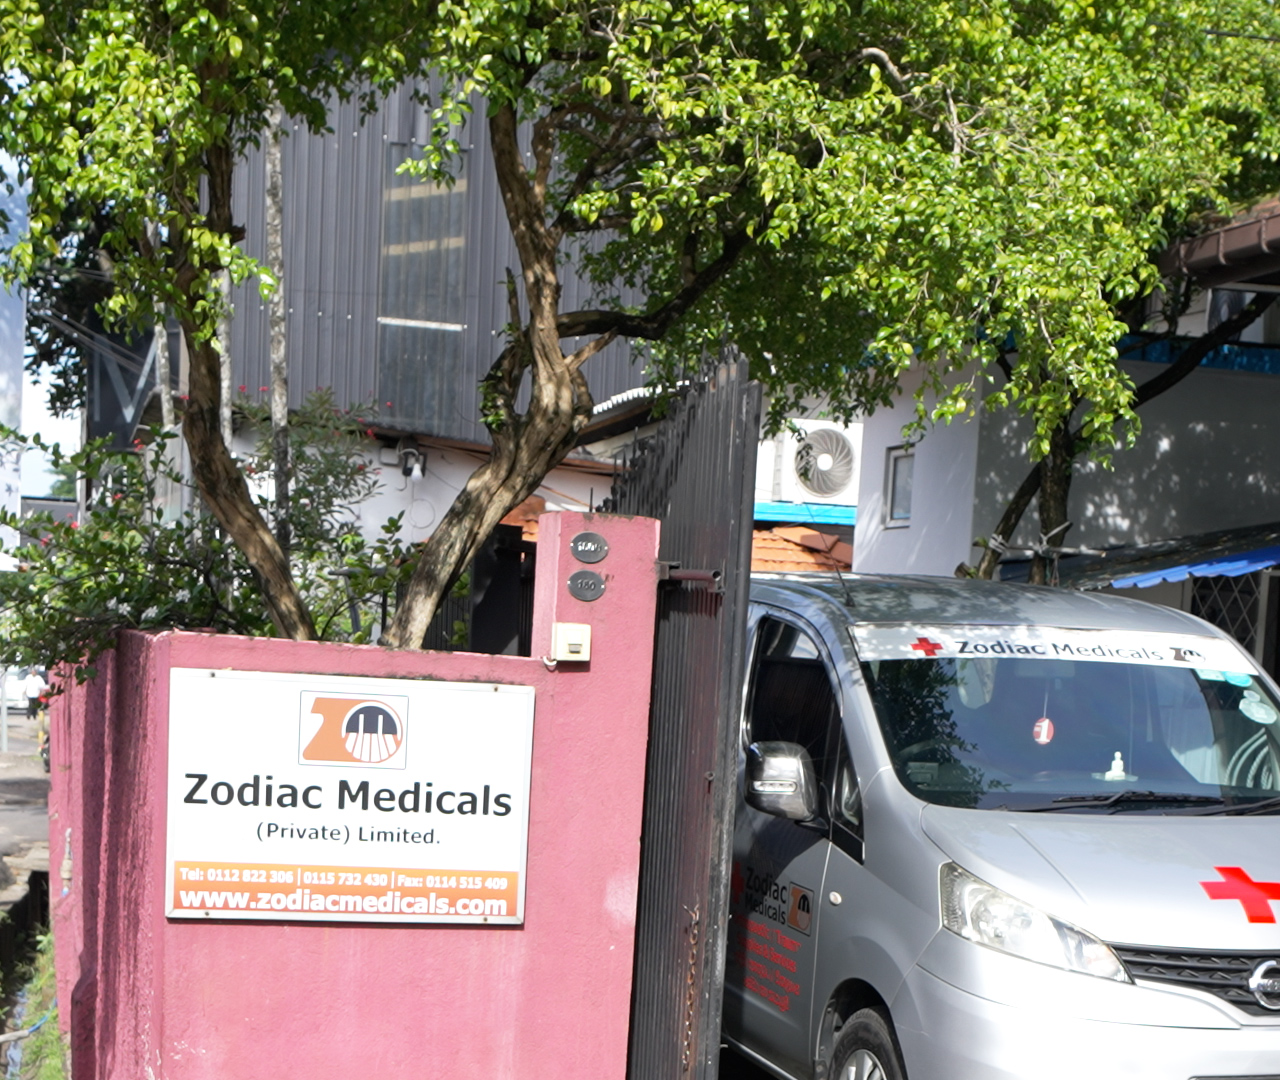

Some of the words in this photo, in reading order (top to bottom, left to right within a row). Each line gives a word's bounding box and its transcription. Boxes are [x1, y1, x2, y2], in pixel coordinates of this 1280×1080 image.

[954, 640, 1047, 655] Zodiac
[1051, 642, 1164, 661] Medicals
[183, 773, 323, 809] Zodiac
[338, 779, 512, 817] Medicals
[257, 822, 350, 845] (Private)
[358, 826, 440, 845] Limited.
[179, 867, 204, 881] Tel:
[207, 868, 240, 882] 0112
[242, 869, 267, 883] 822
[269, 870, 294, 884] 306
[303, 871, 335, 885] 0115
[338, 872, 362, 886] 732
[363, 873, 388, 886] 430
[397, 874, 423, 888] Fax:
[426, 875, 457, 889] 0114
[459, 876, 482, 889] 515
[484, 877, 508, 890] 409
[745, 867, 788, 904] Zodiac
[179, 888, 508, 916] www.zodiacmedicals.com
[744, 892, 787, 925] Medicals
